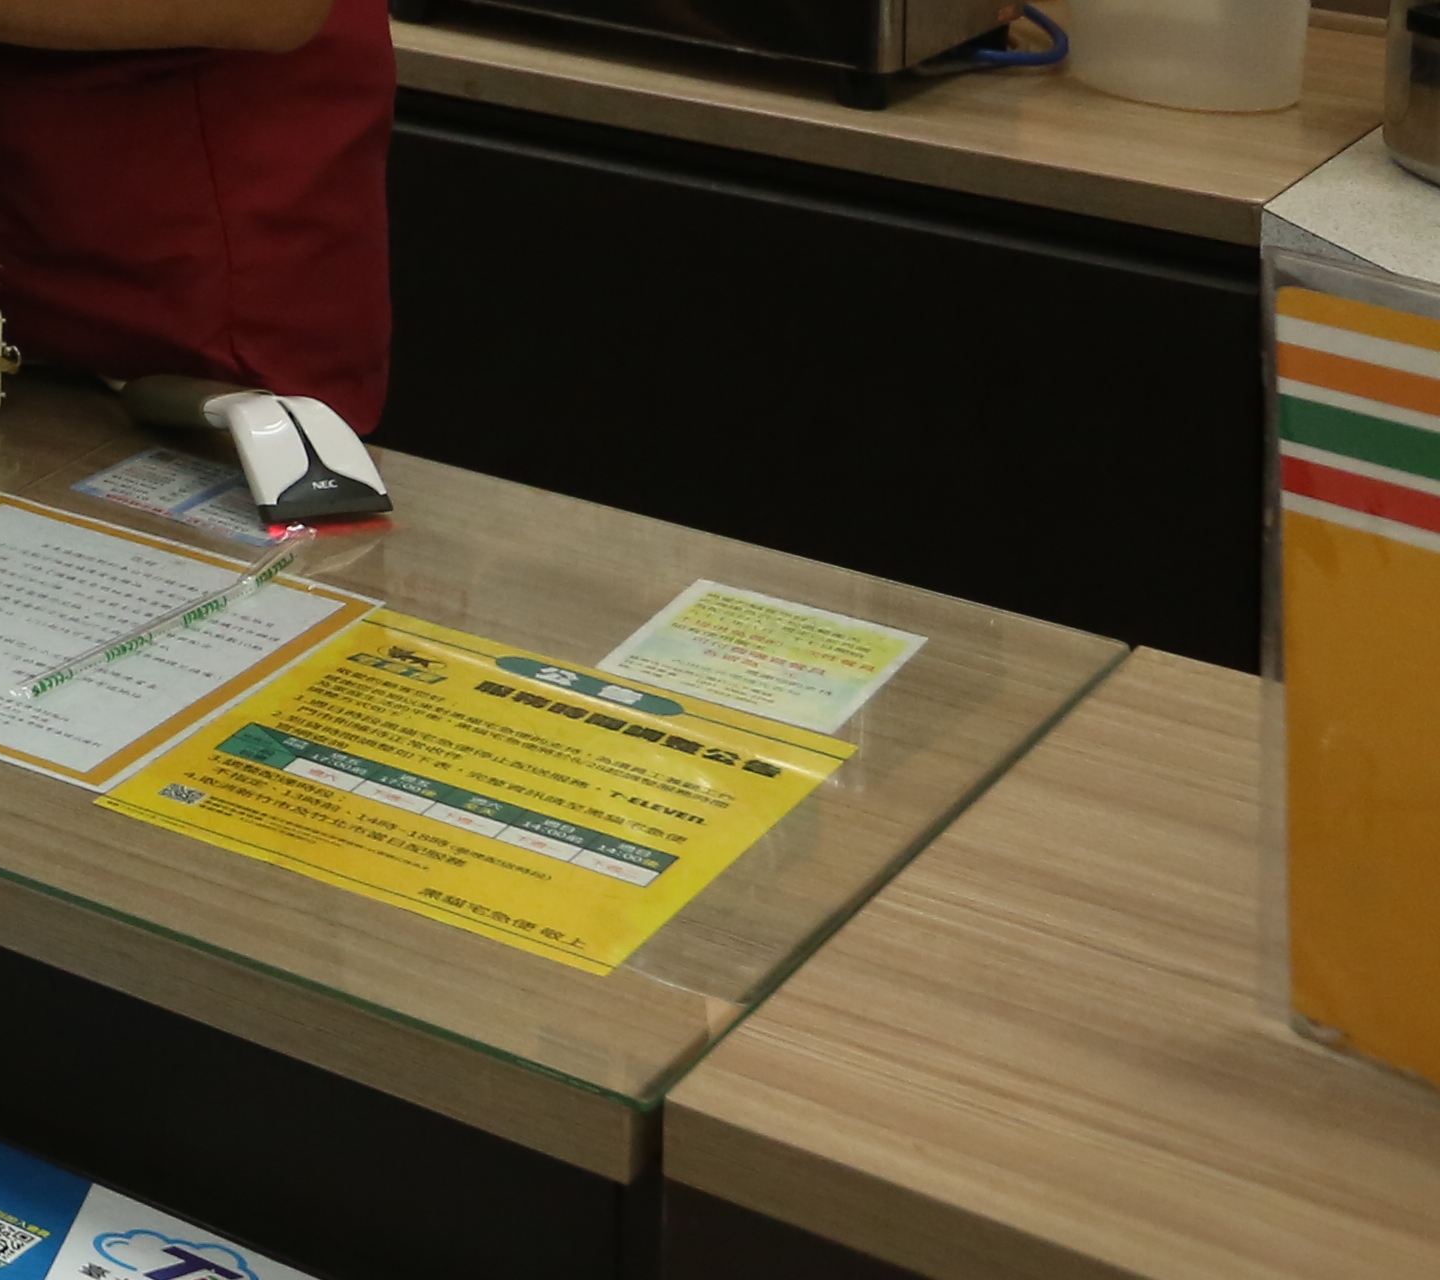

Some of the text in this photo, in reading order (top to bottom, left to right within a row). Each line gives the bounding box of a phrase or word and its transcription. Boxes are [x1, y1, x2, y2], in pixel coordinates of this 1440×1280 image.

[311, 478, 338, 491] NEC
[529, 664, 649, 706] 公告
[472, 679, 786, 779] 服務時間調整公告
